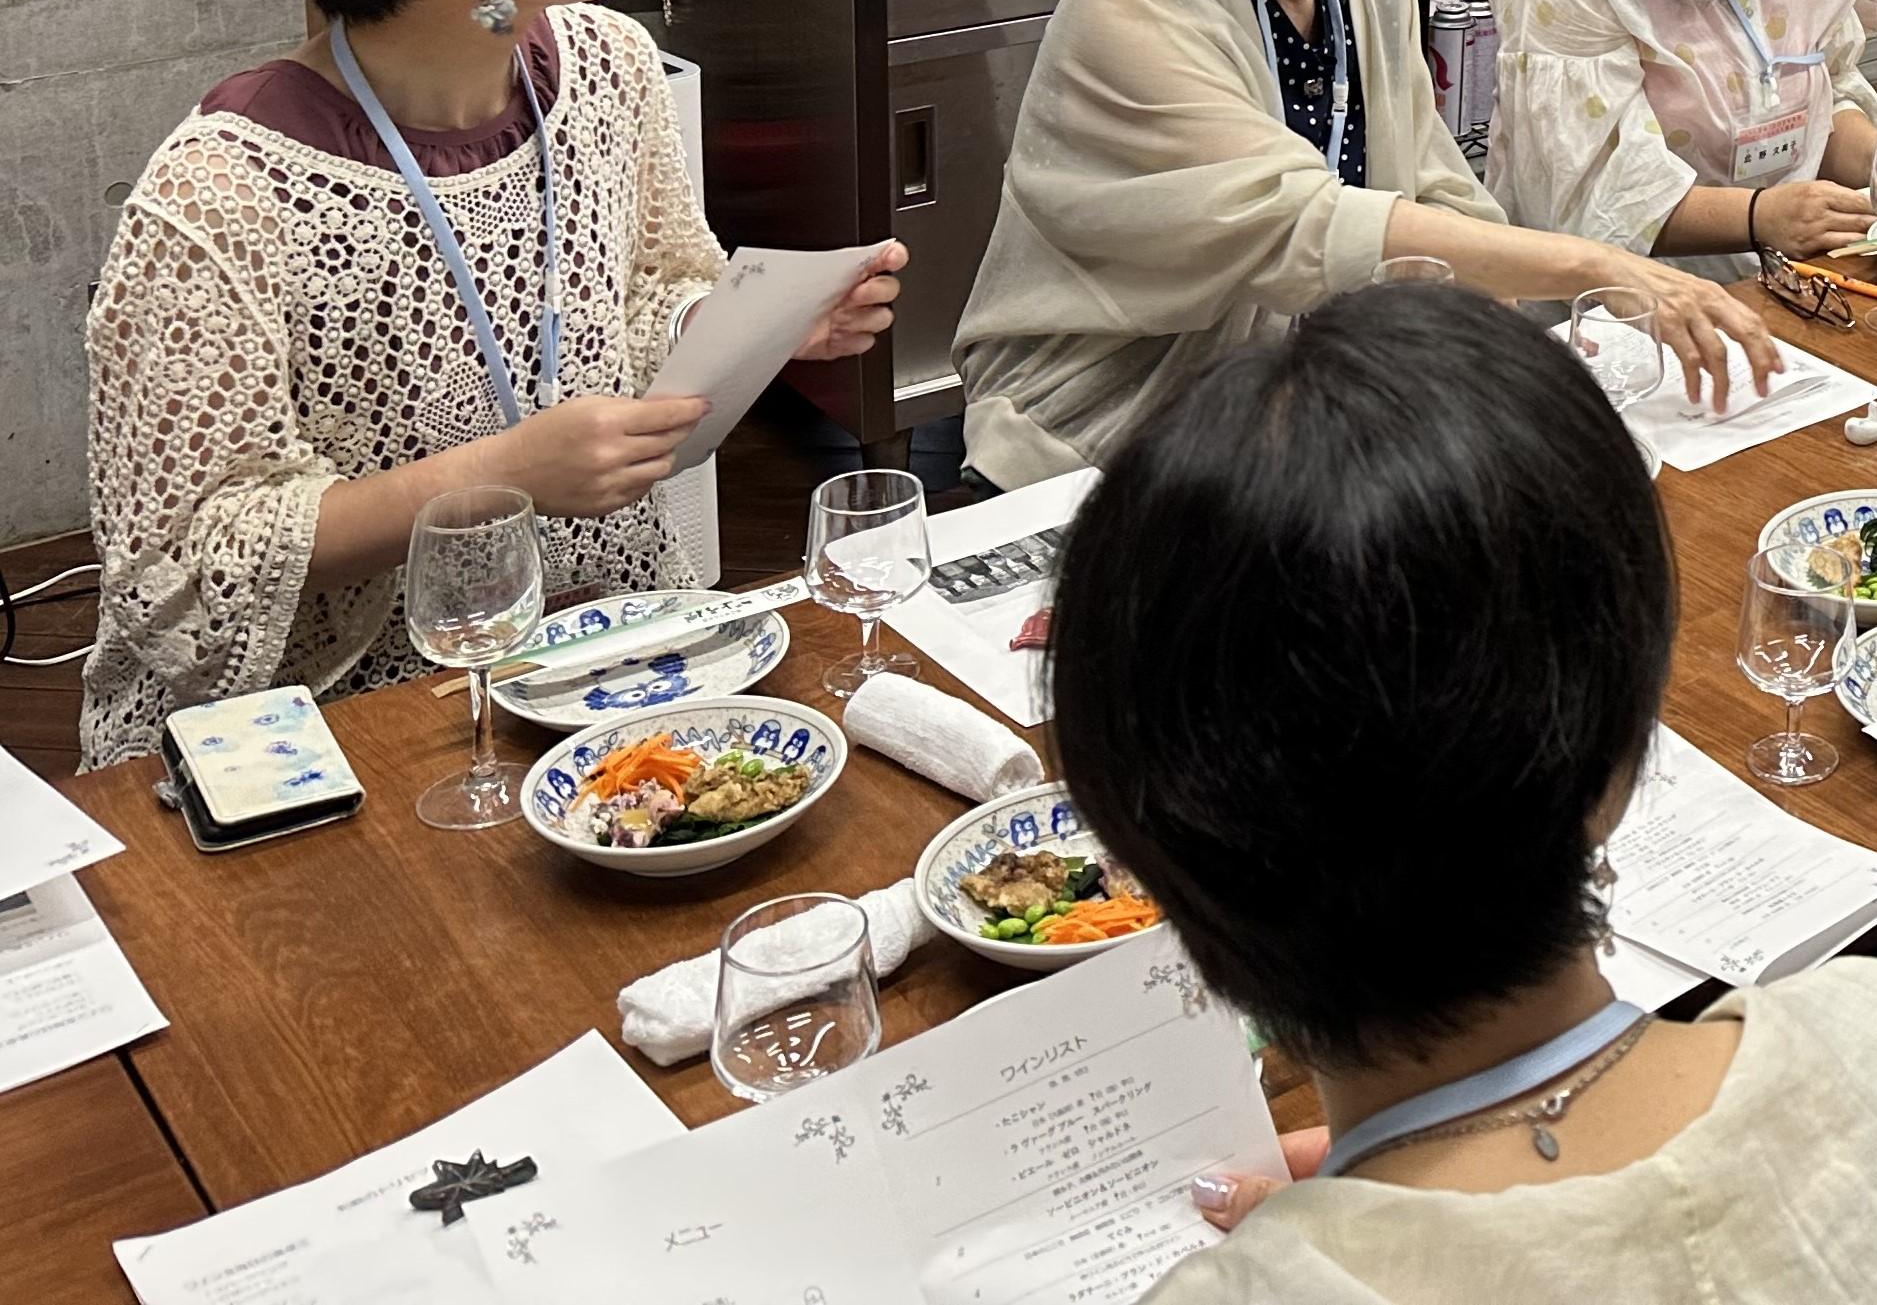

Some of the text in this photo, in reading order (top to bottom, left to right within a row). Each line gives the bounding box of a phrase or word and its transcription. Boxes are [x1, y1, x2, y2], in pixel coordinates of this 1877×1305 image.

[1000, 1035, 1088, 1082] ワインリスト
